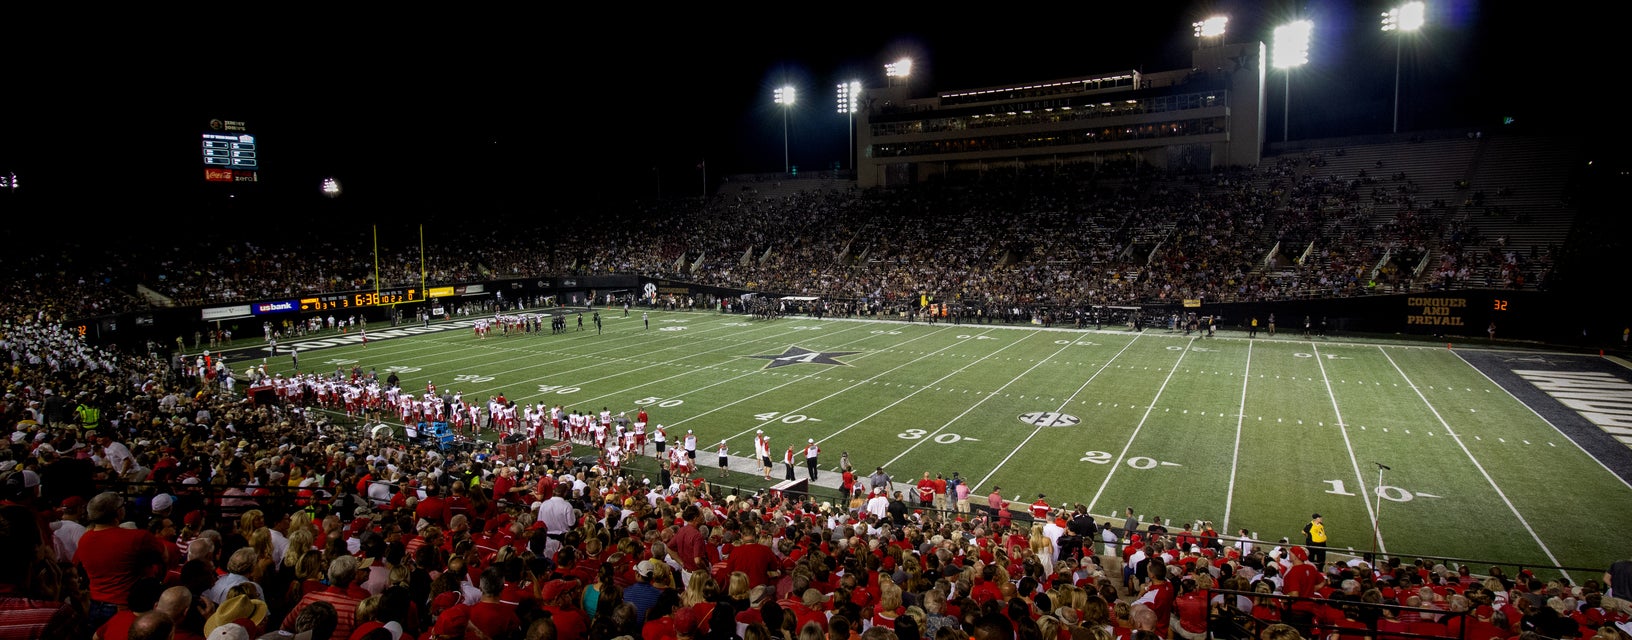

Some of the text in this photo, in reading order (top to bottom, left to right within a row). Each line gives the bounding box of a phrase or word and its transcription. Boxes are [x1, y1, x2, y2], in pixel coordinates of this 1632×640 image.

[1407, 297, 1467, 307] CONQUER
[1493, 299, 1508, 311] 32
[1422, 306, 1450, 315] AND
[1407, 315, 1465, 326] PREVAIL
[634, 396, 684, 408] 50
[754, 411, 807, 424] 40
[898, 428, 961, 444] 30
[1080, 451, 1158, 469] 20
[1323, 479, 1414, 501] 10
